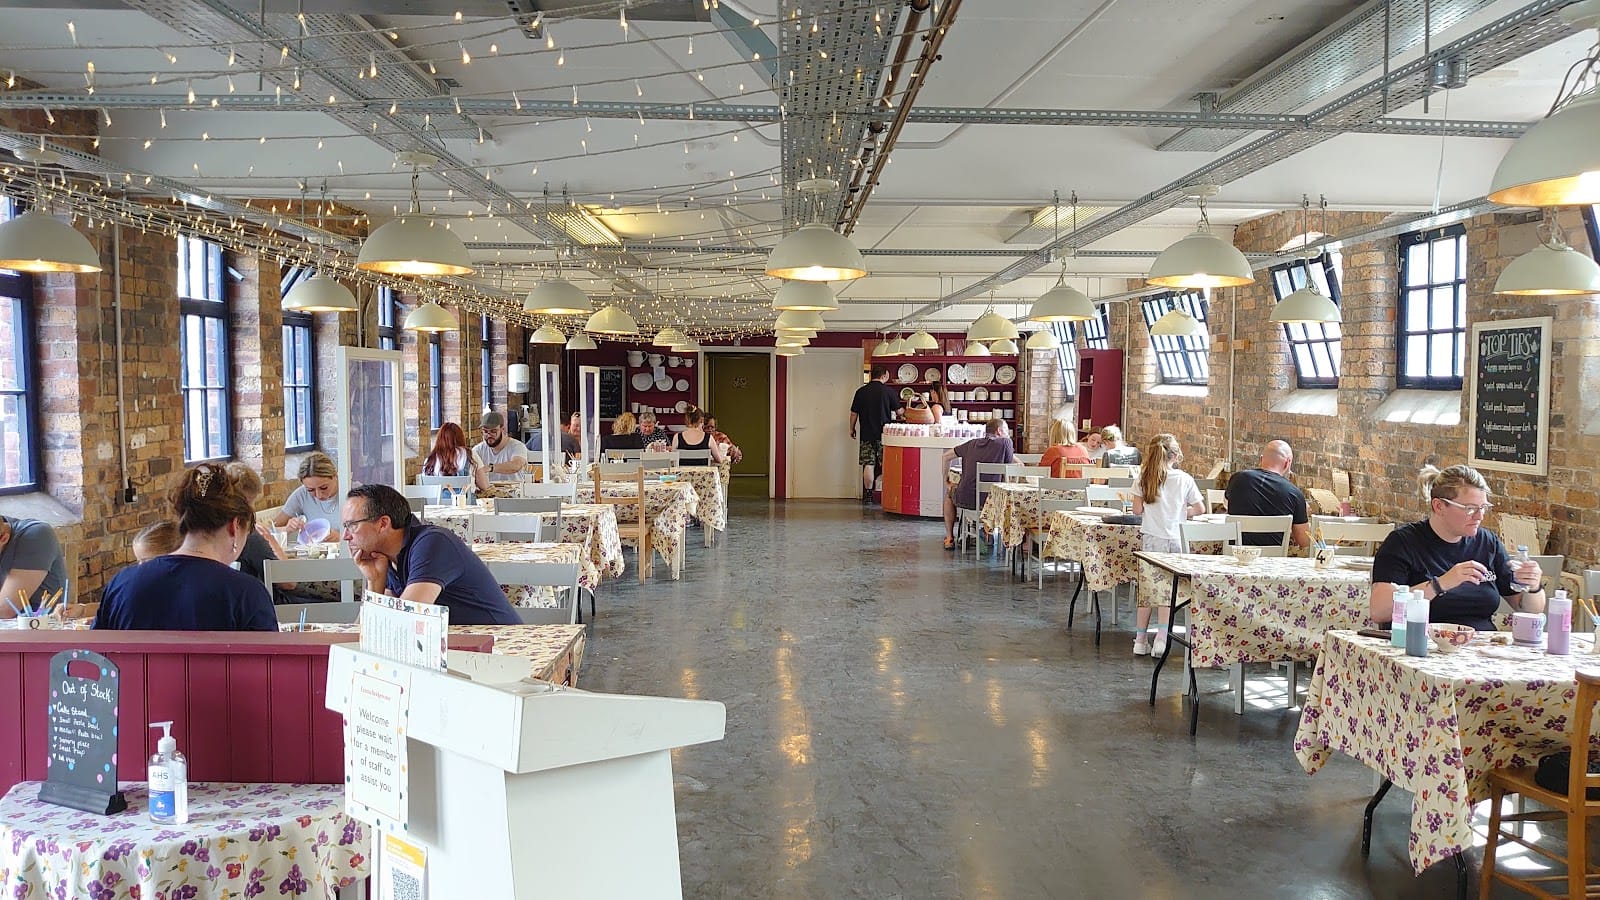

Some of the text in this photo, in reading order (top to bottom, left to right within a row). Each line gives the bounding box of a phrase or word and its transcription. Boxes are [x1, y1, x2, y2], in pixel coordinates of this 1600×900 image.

[1487, 334, 1507, 356] TOP
[1525, 453, 1536, 464] EB
[1316, 549, 1326, 564] 4
[29, 618, 40, 630] Q
[62, 680, 76, 695] Out
[80, 684, 88, 702] of
[57, 701, 89, 718] Cake Stand
[359, 706, 390, 728] Welcome
[356, 725, 393, 745] please wait
[353, 736, 397, 762] for a member
[152, 771, 169, 780] AHS
[360, 756, 392, 776] of staff to
[360, 773, 392, 792] assist you
